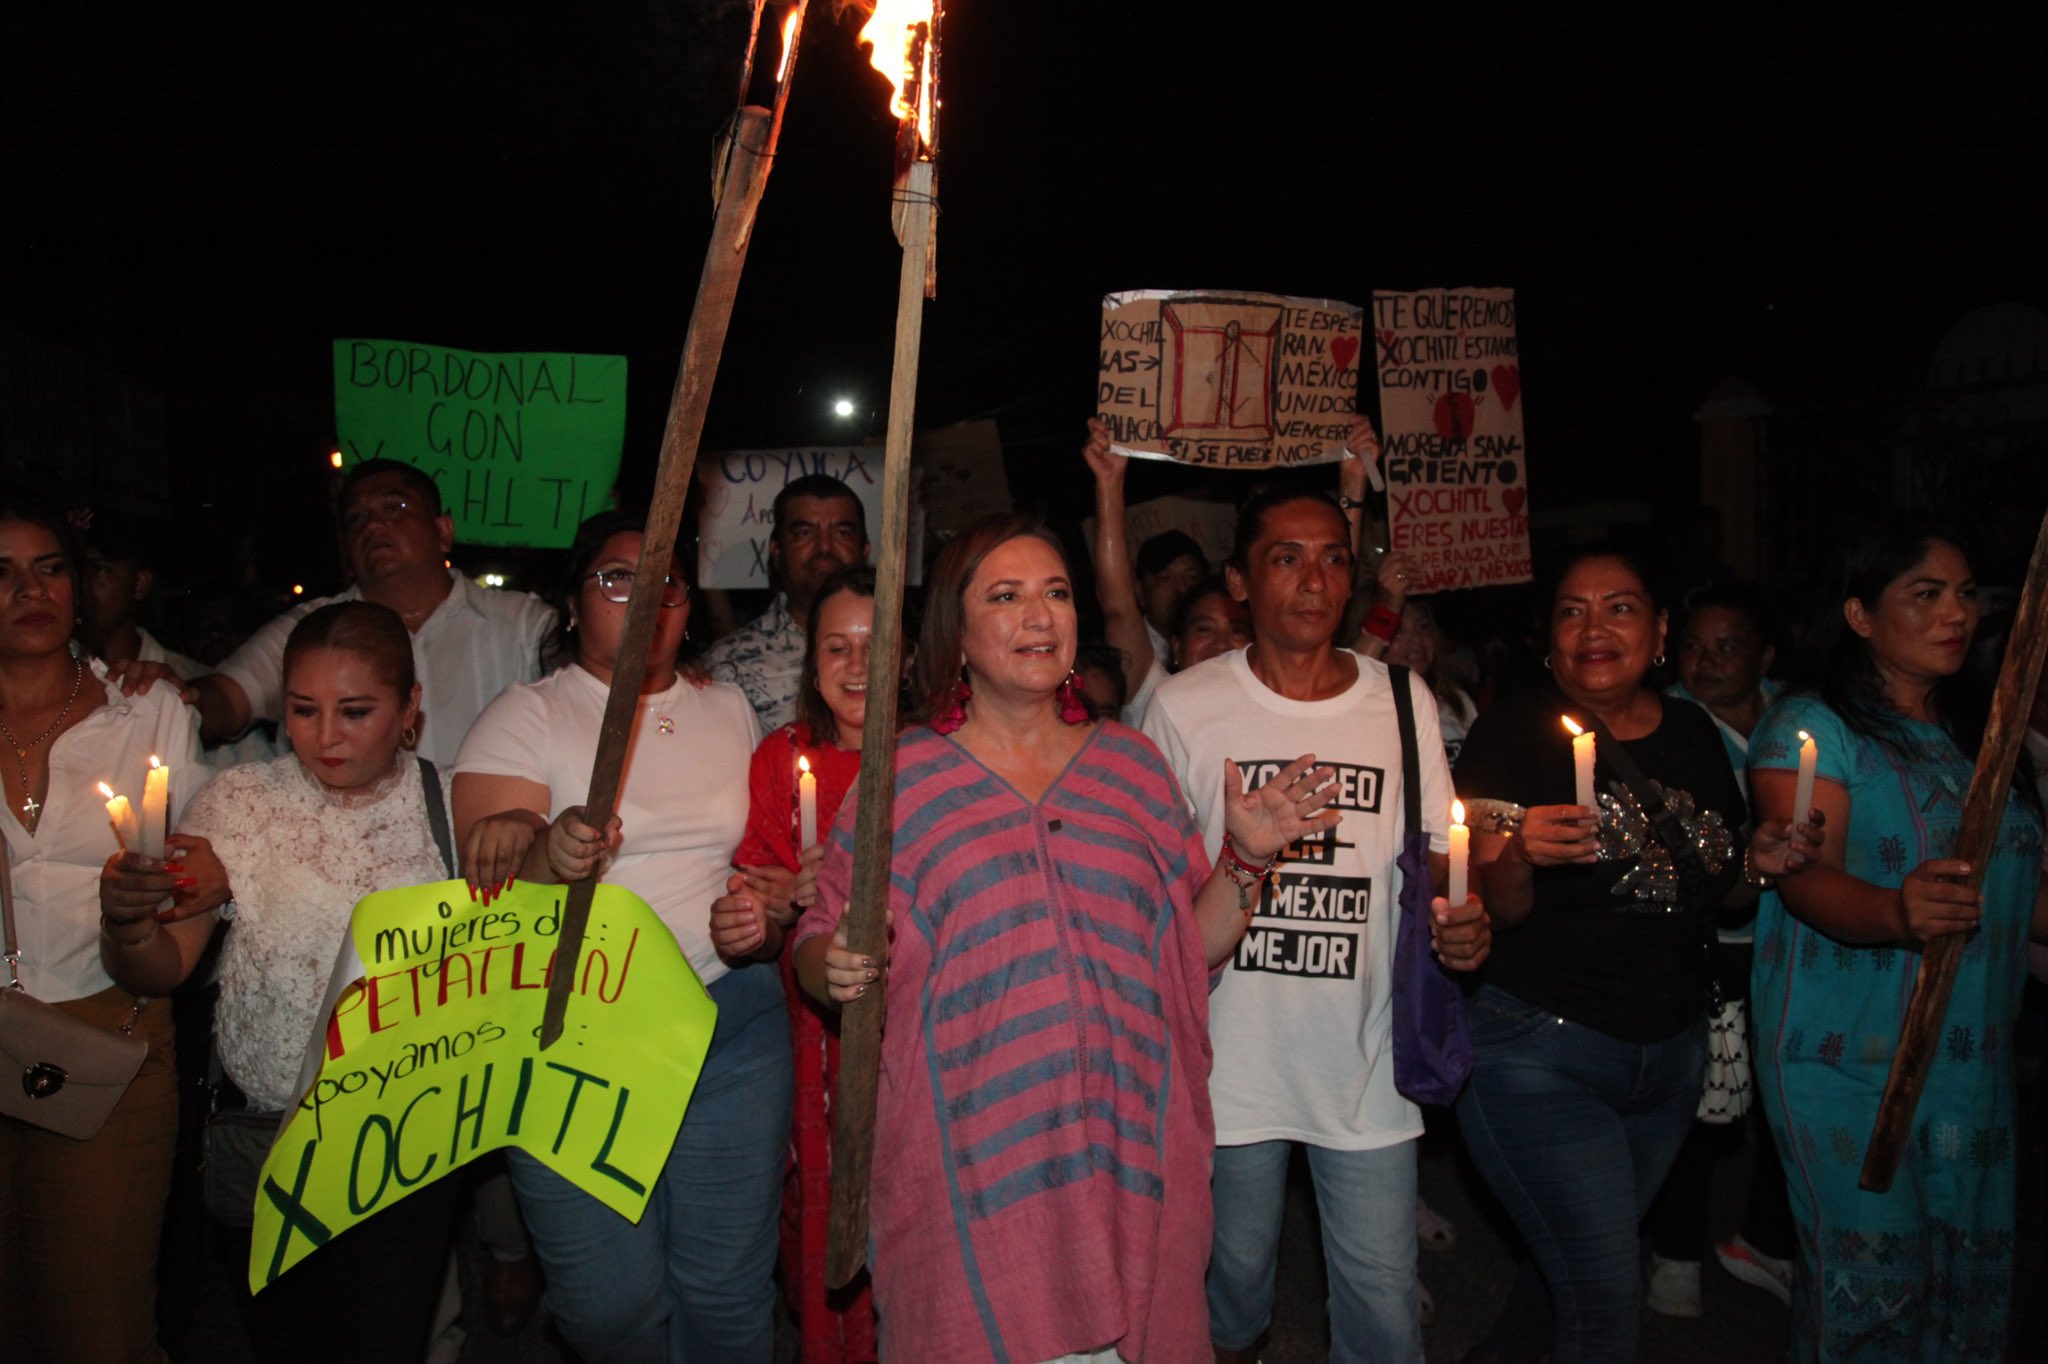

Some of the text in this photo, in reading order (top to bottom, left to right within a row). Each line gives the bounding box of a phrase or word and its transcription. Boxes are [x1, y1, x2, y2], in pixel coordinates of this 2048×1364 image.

[1282, 308, 1308, 328] TE
[1373, 294, 1514, 330] TE QUEREMOS
[351, 341, 604, 406] BORDONAL
[1100, 350, 1140, 374] LAS
[1100, 382, 1155, 408] DEL
[1382, 368, 1487, 395] CONTIGO
[1278, 391, 1356, 415] UNIDOS
[1193, 445, 1219, 463] SE
[1391, 488, 1492, 523] XOCHITL
[1393, 521, 1454, 548] ERES
[1271, 877, 1368, 922] MÉXICO
[375, 901, 520, 977] mujeres
[1239, 931, 1351, 976] MEJOR
[262, 1057, 647, 1284] XOCHITL
